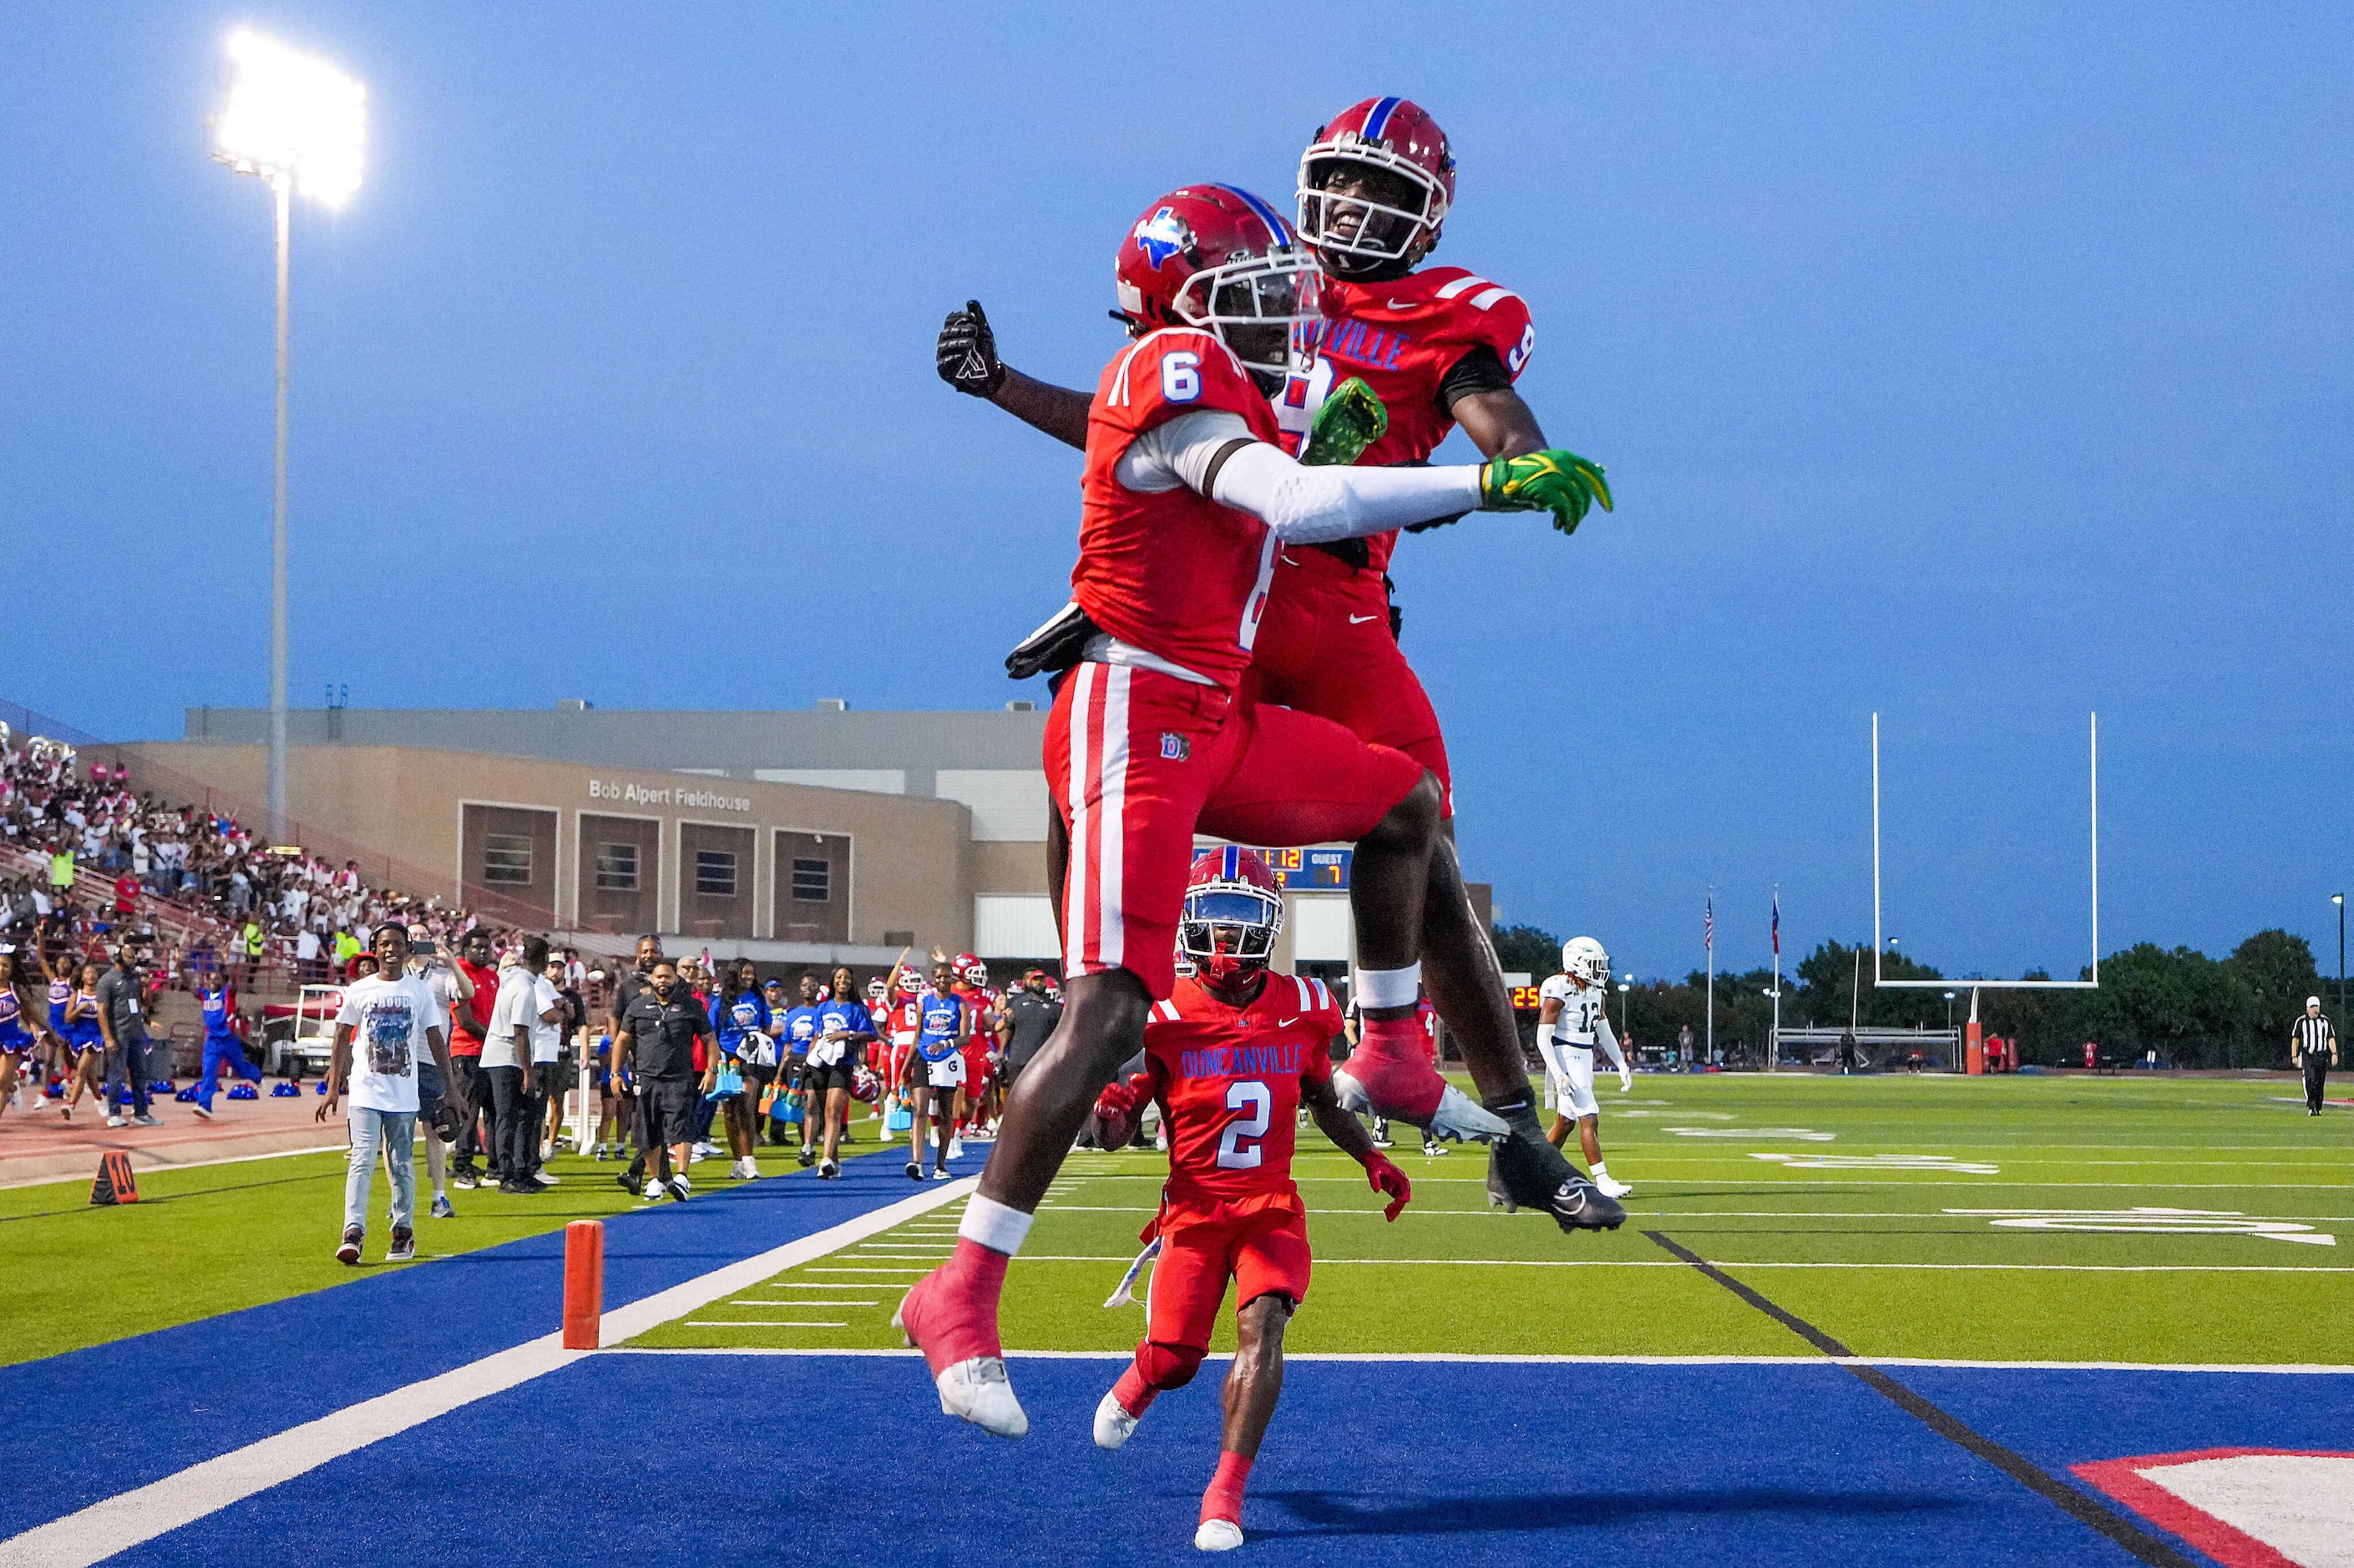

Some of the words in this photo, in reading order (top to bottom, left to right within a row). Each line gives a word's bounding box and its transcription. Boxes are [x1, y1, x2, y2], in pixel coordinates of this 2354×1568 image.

[1507, 322, 1535, 374] 9
[1161, 350, 1202, 403] 6
[589, 779, 620, 801] Bob
[625, 783, 671, 806] Alpert
[675, 787, 751, 812] Fieldhouse
[1311, 852, 1344, 866] GUEST
[1329, 865, 1341, 885] 7
[1512, 986, 1540, 1009] 25
[904, 1003, 918, 1027] 6
[1578, 1002, 1599, 1034] 12
[1182, 1044, 1303, 1079] DUNCANVILLE
[1217, 1080, 1272, 1168] 2
